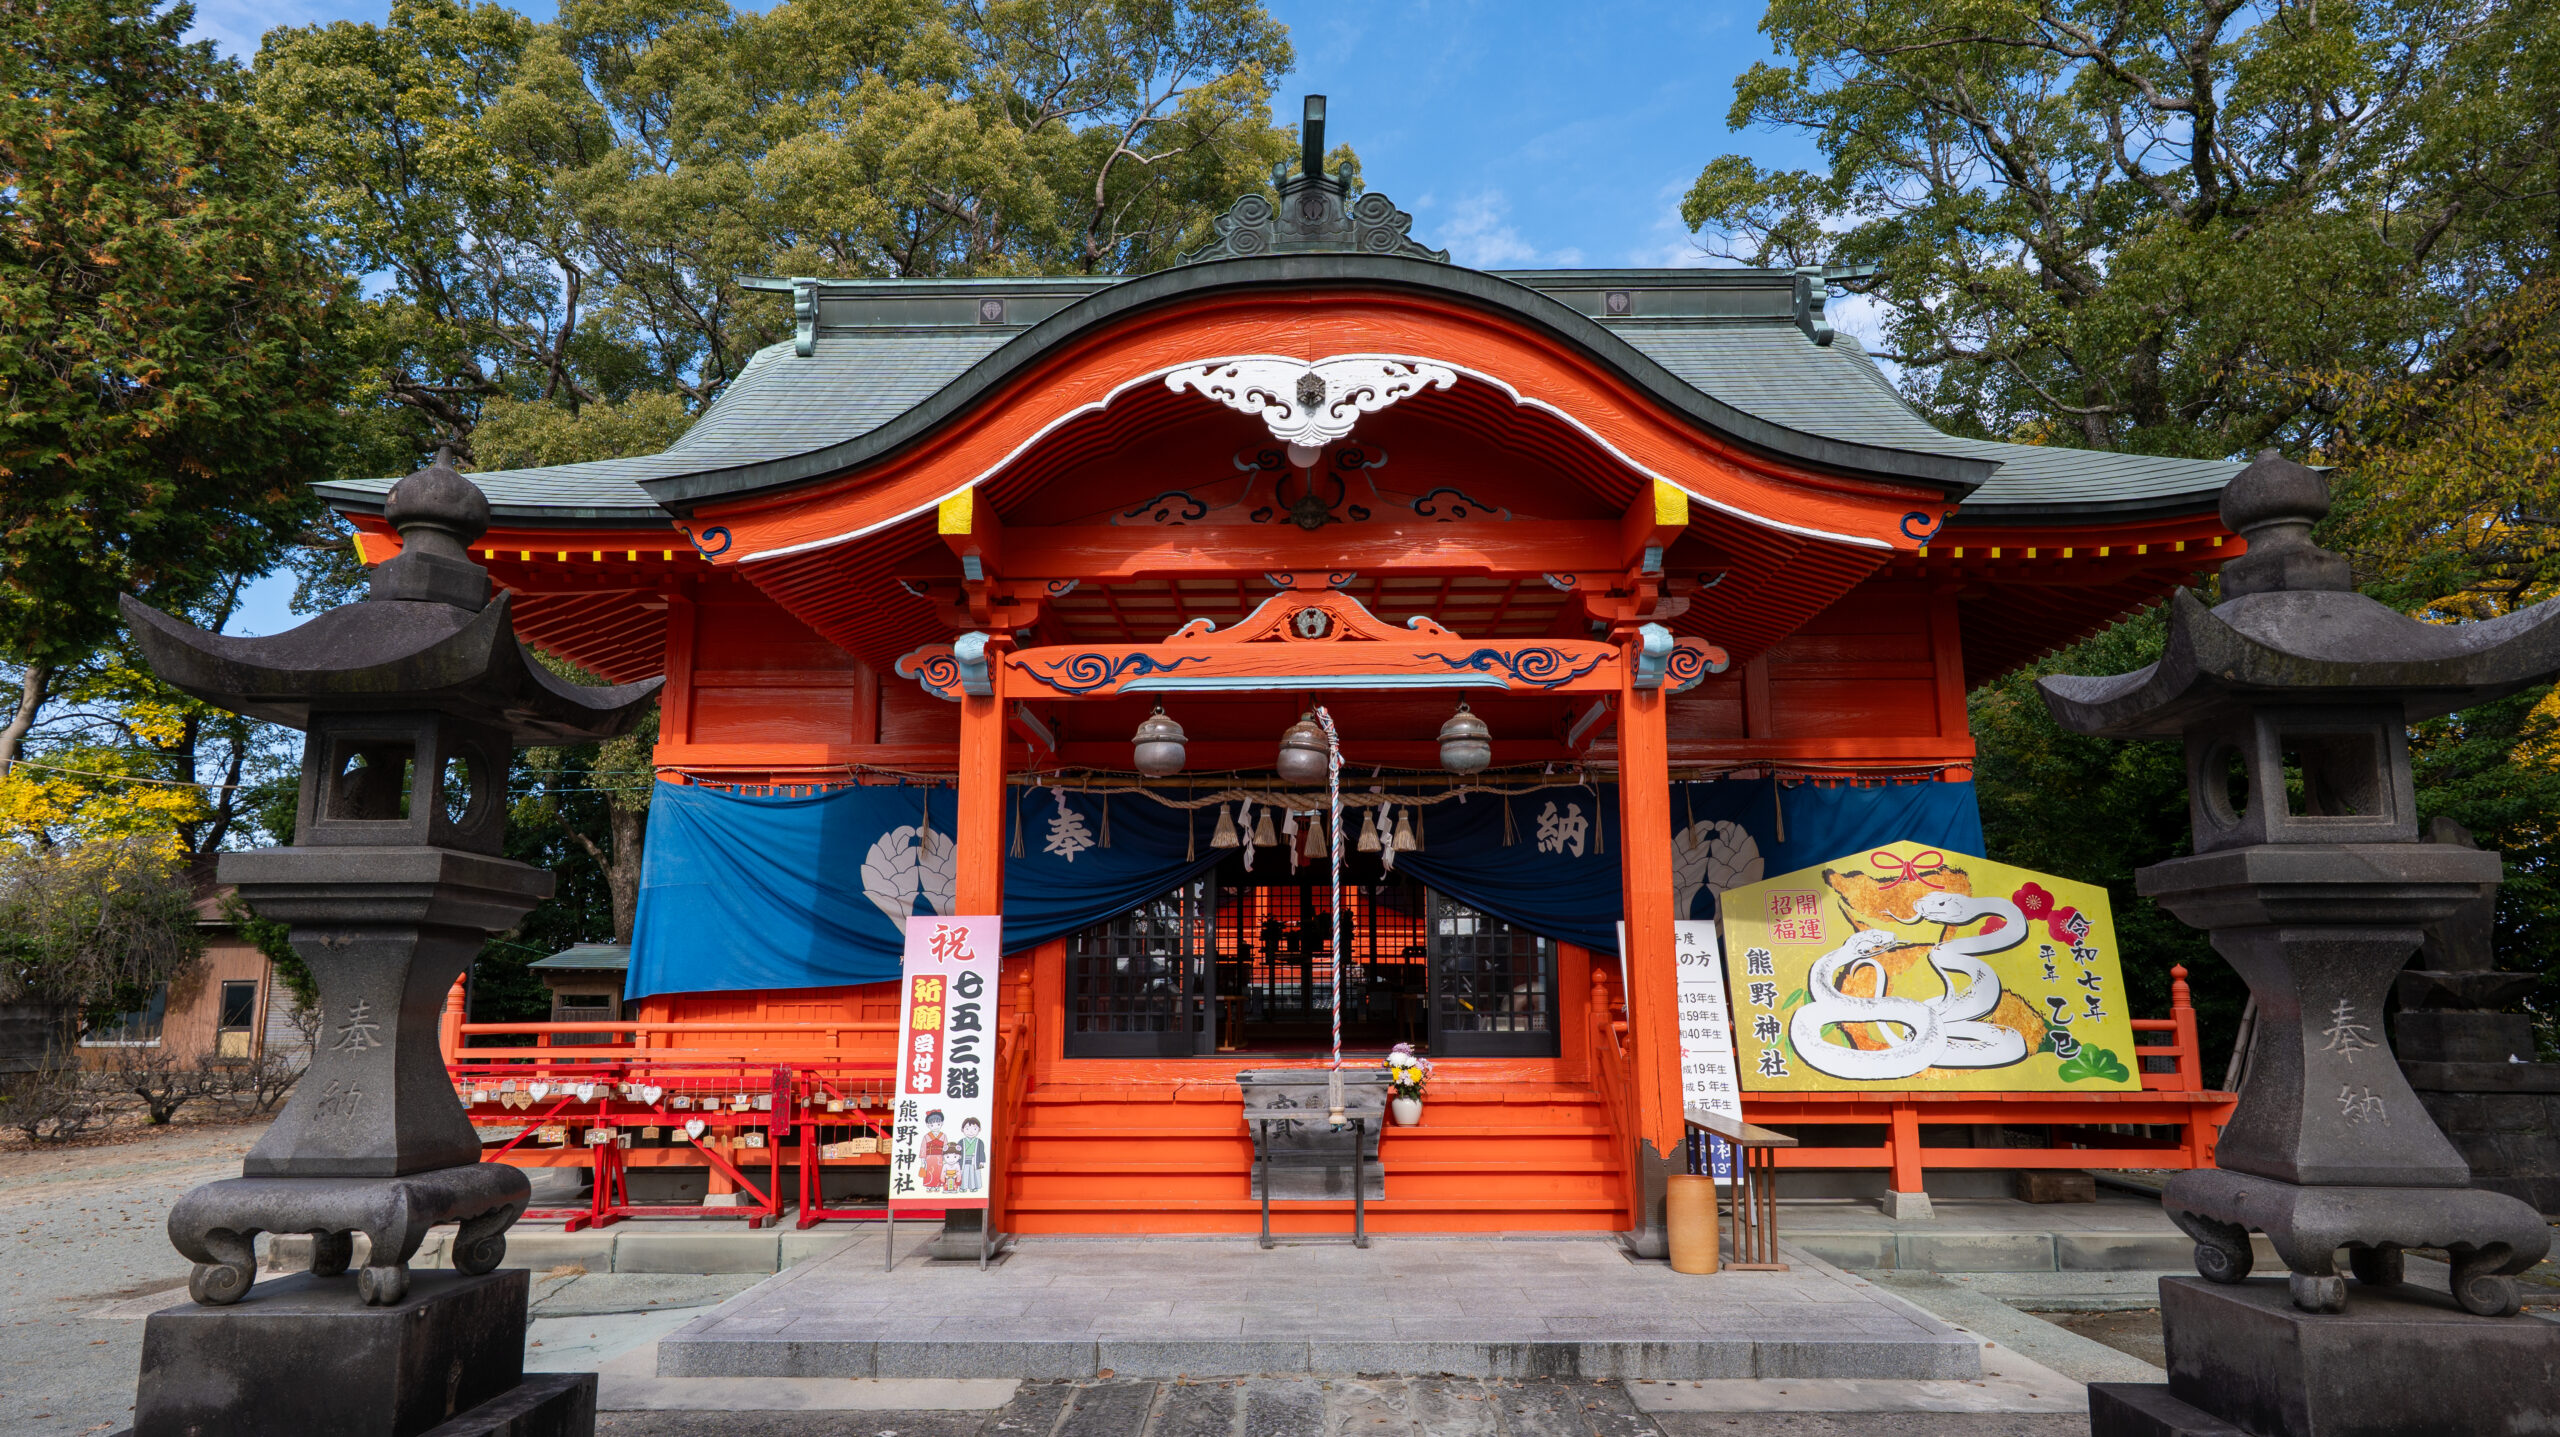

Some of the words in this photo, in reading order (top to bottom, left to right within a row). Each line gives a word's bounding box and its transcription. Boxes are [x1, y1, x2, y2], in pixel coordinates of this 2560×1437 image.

[1536, 801, 1589, 858] 納
[929, 924, 976, 963] 祝
[1771, 895, 1797, 940] 招福
[1796, 894, 1824, 940] 開運
[2067, 911, 2107, 1022] 令和七年
[313, 996, 383, 1122] 奉納
[911, 978, 943, 1093] 祈願受付中
[946, 970, 984, 1099] 七五三詣
[1746, 948, 1789, 1078] 熊野神社
[2320, 998, 2391, 1128] 奉納
[893, 1100, 919, 1195] 熊野神社
